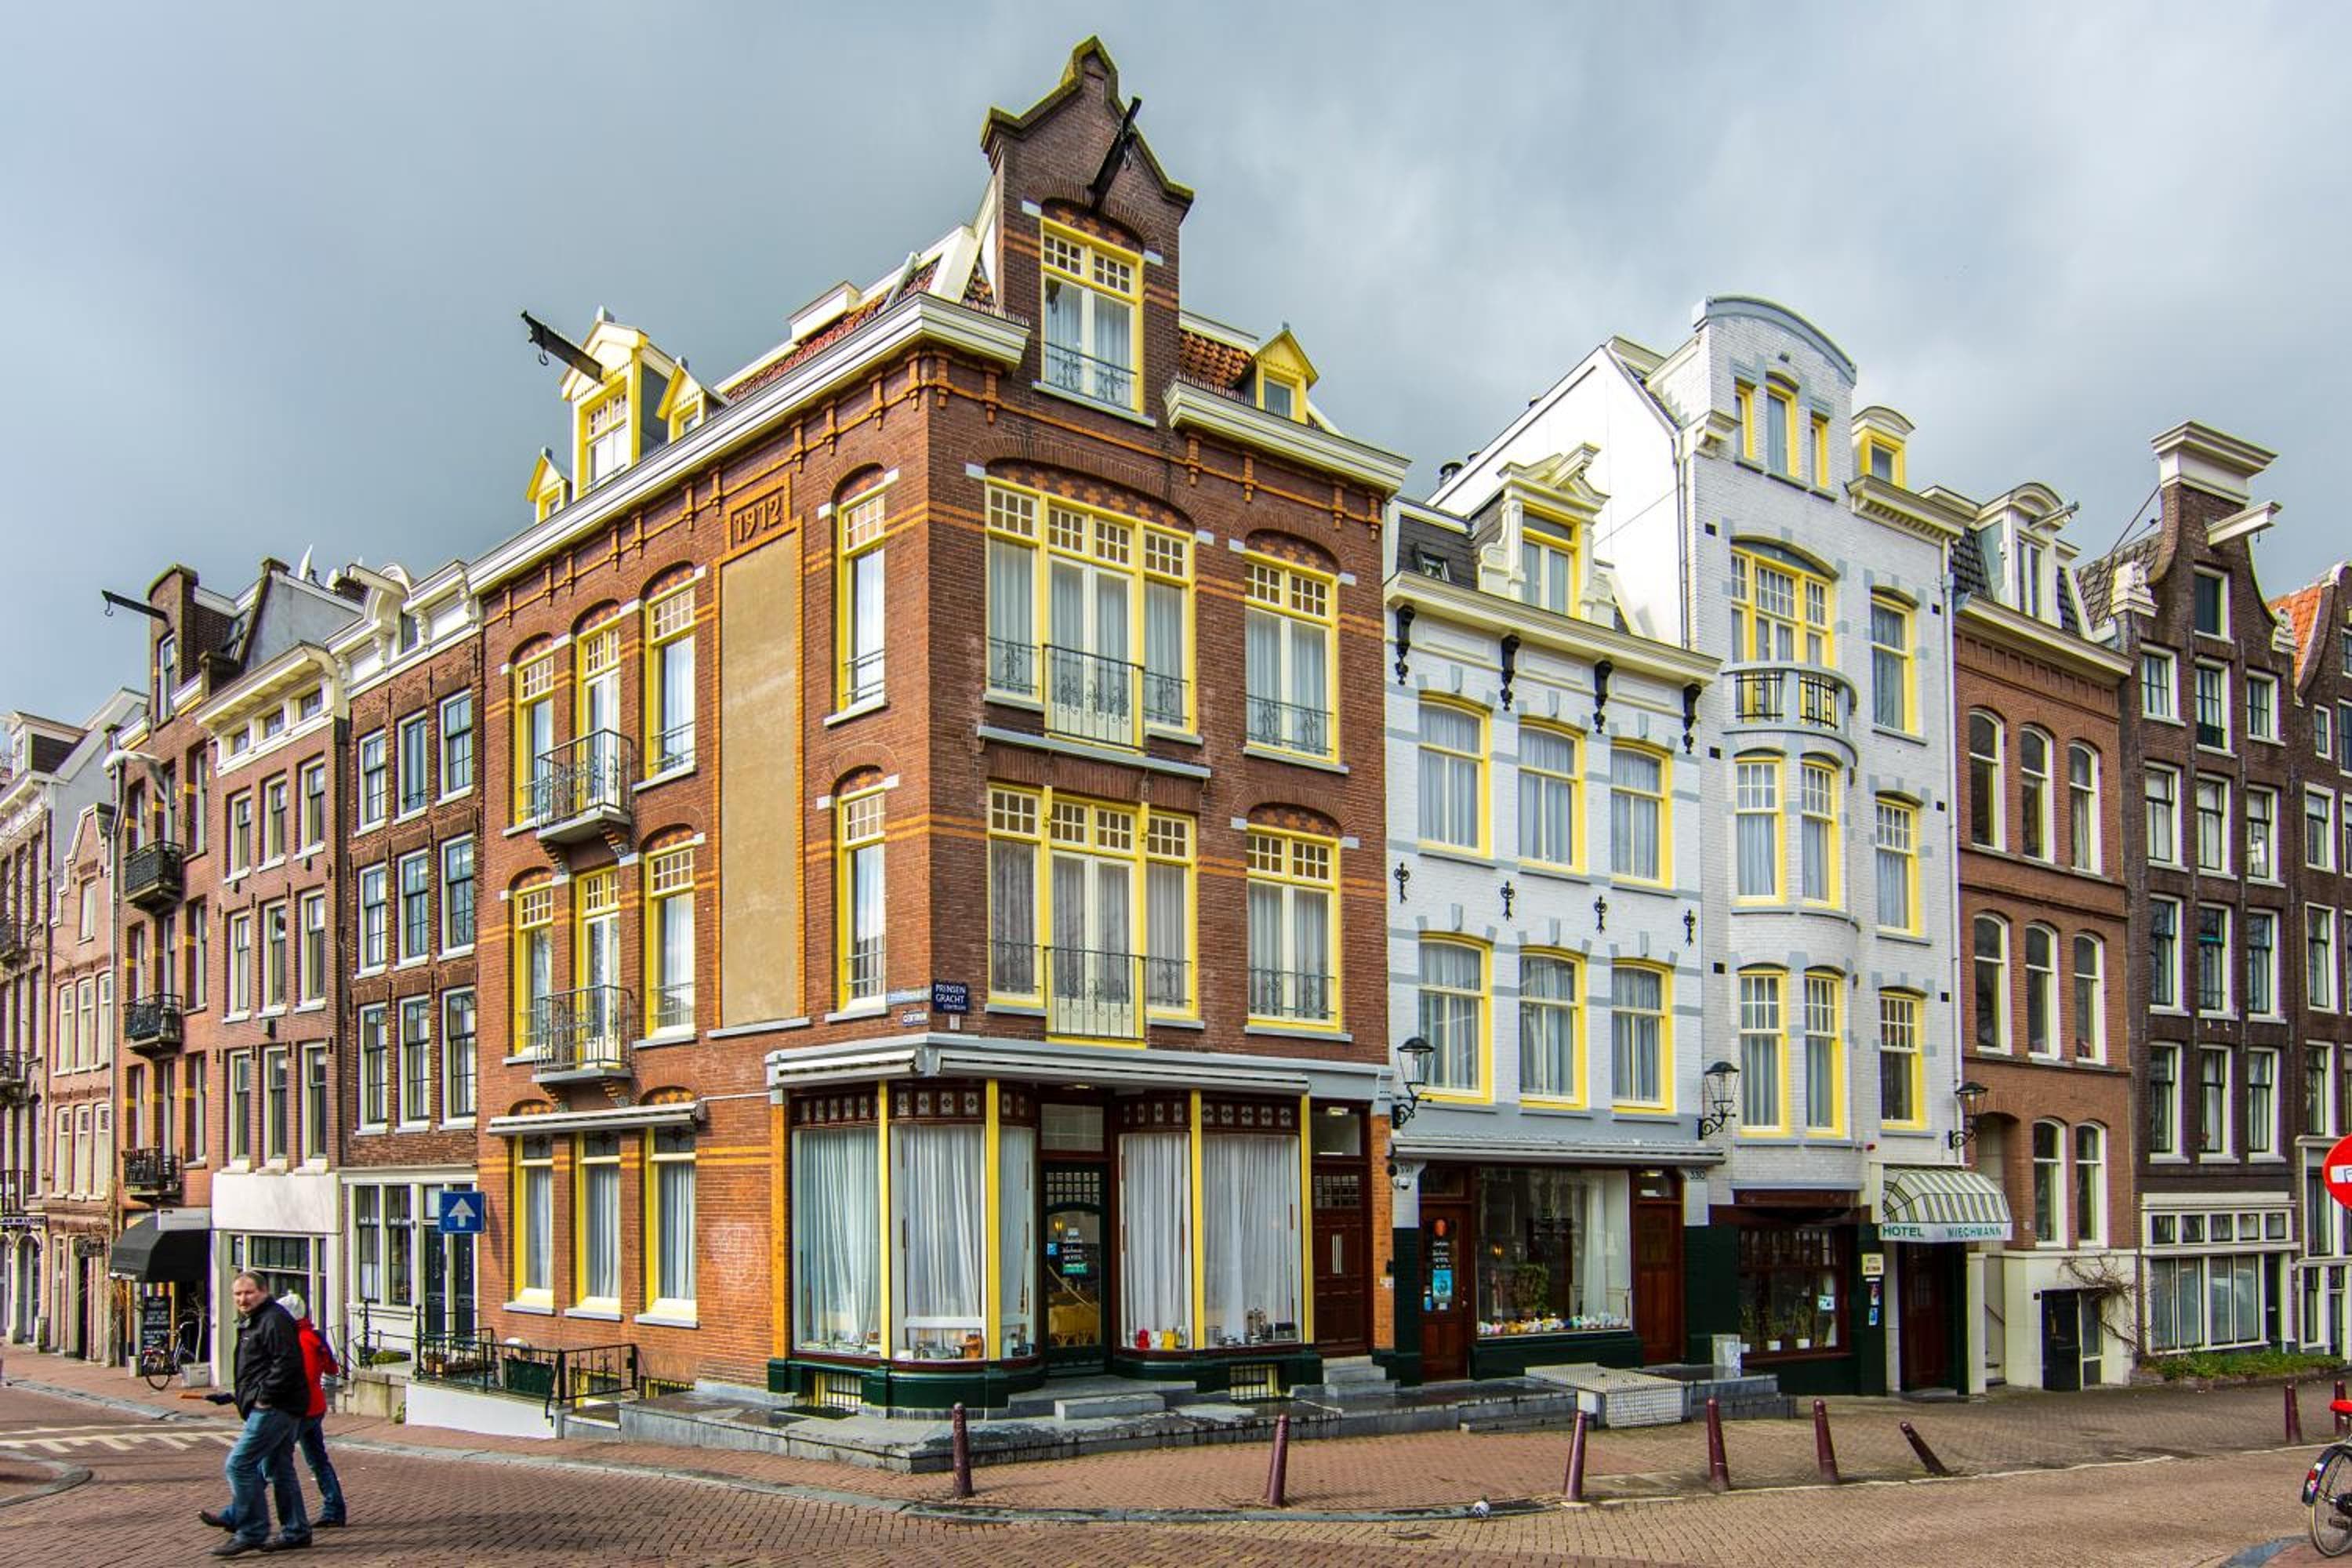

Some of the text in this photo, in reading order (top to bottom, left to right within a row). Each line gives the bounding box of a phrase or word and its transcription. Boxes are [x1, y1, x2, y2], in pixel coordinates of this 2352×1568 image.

[734, 495, 782, 543] 1912
[935, 984, 967, 994] PRINSEN
[935, 993, 965, 1004] GRACHT
[1882, 1226, 2002, 1238] HOTEL WIECHMANN
